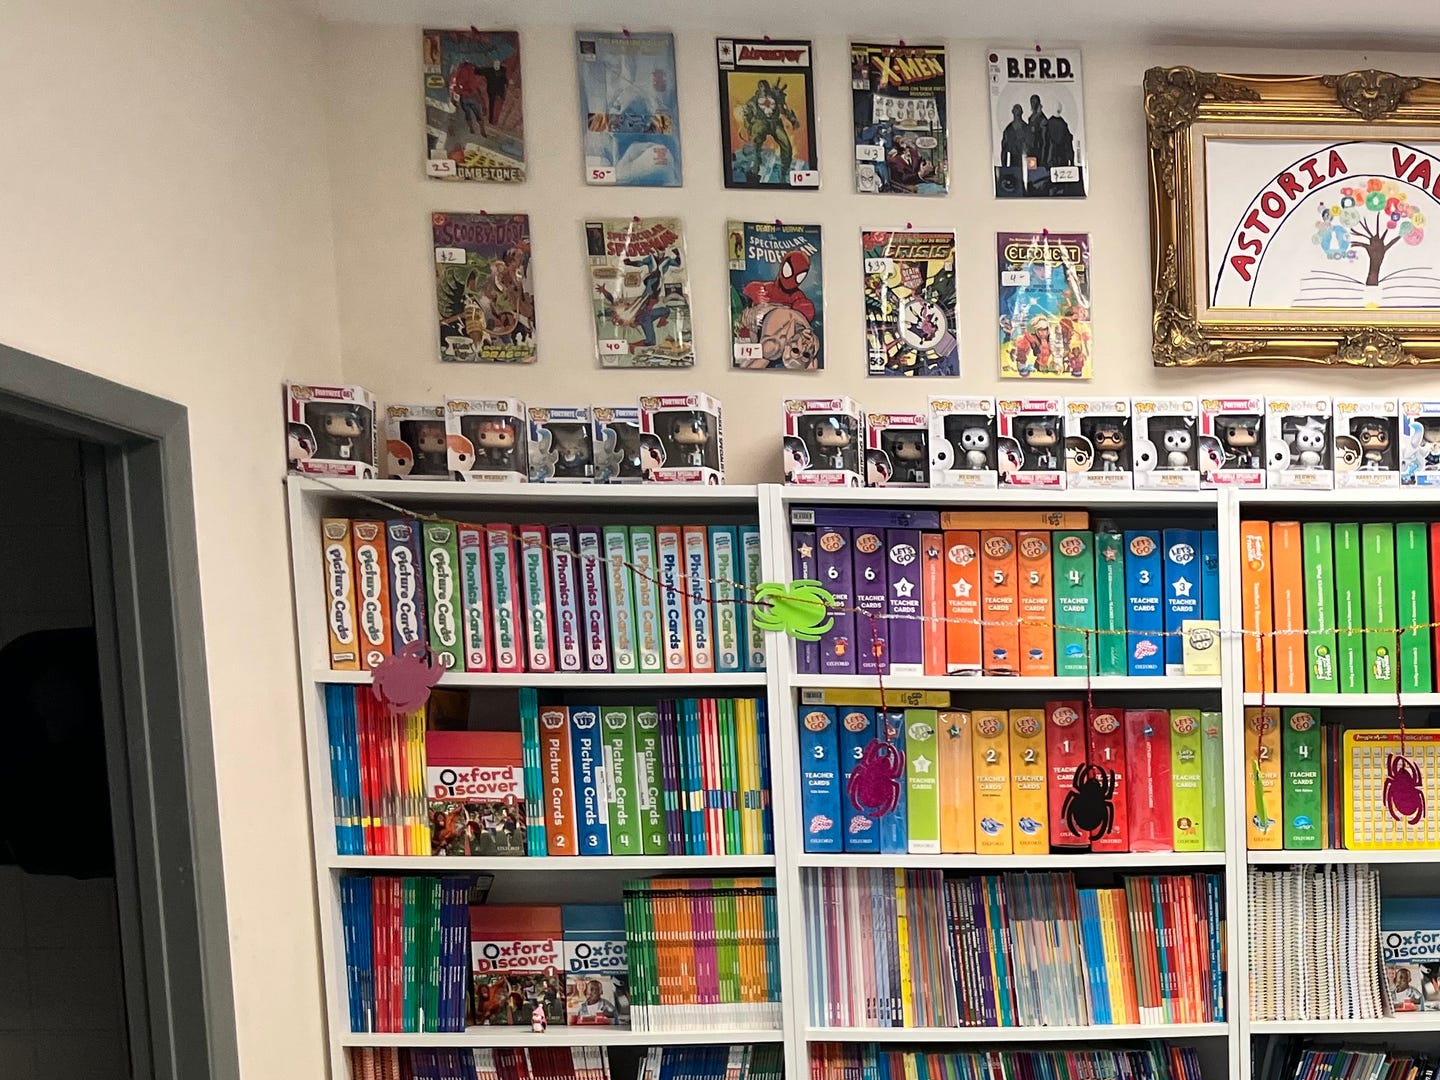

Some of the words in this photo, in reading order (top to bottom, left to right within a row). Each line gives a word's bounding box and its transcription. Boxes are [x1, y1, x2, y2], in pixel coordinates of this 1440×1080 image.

[871, 55, 944, 88] X-MEN
[1006, 57, 1074, 79] B.P.R.D.
[1230, 150, 1349, 282] ASTORIA
[750, 235, 809, 250] SPECTACULAR
[862, 543, 876, 551] GO
[896, 554, 912, 563] GO
[1066, 547, 1079, 556] GO
[361, 549, 377, 598] Picture
[465, 552, 478, 605] Phonics
[494, 552, 508, 605] Phonics
[557, 554, 570, 607] Phonics
[864, 567, 876, 581] 6
[1068, 569, 1080, 584] 4
[334, 600, 350, 641] Cards
[366, 601, 381, 642] Cards
[527, 553, 541, 606] Phonics
[534, 608, 546, 650] Cards
[469, 608, 482, 649] Cards
[499, 608, 512, 649] Cards
[562, 609, 574, 651] Cards
[589, 610, 602, 651] Cards
[617, 610, 629, 650] Cards
[668, 609, 681, 650] Cards
[549, 738, 560, 785] Picture
[581, 738, 592, 784] Picture
[612, 738, 625, 785] Picture
[813, 746, 825, 759] 3
[1298, 745, 1309, 759] 4
[434, 780, 518, 800] Discover
[440, 766, 514, 787] Oxford
[552, 787, 564, 827] Cards
[583, 787, 595, 827] Cards
[616, 787, 627, 827] Cards
[556, 836, 566, 847] 2
[588, 836, 598, 848] 3
[620, 835, 630, 847] 4
[478, 954, 558, 973] Discover
[483, 938, 554, 959] Oxford
